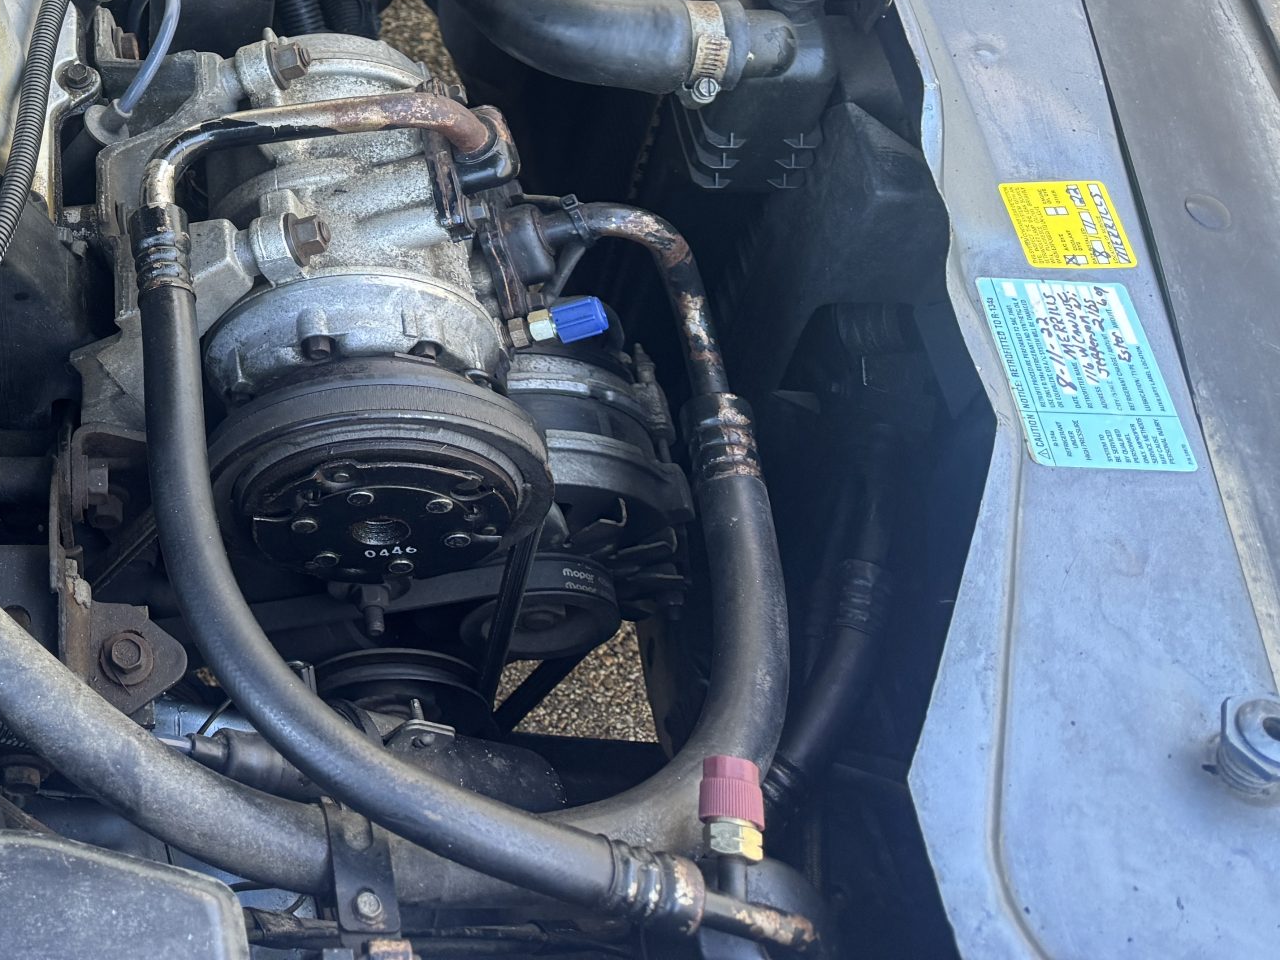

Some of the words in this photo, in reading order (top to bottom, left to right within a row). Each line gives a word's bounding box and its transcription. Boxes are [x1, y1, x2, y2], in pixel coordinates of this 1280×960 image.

[992, 319, 1003, 328] TO
[1101, 333, 1113, 352] AMOUNT
[996, 330, 1019, 377] RETROFITTED
[1110, 357, 1122, 376] CHARGE
[1071, 396, 1081, 408] DATE
[1094, 386, 1108, 409] ADDRESS
[1118, 377, 1135, 411] REFRIGERANT
[1026, 414, 1044, 447] CAUTION
[1055, 421, 1072, 457] REFRIGERANT
[1067, 430, 1079, 448] UNDER
[1071, 419, 1087, 447] PRESSURE
[1098, 433, 1105, 441] TO
[1135, 417, 1149, 442] METHODS
[1101, 441, 1113, 462] SYSTEM
[1104, 429, 1118, 454] SERVICED
[1113, 428, 1128, 455] QUALIFIED
[1124, 433, 1140, 463] PERSONNEL
[1151, 435, 1163, 453] CAUSE
[1160, 438, 1175, 464] PERSONAL
[1082, 447, 1092, 460] HIGH
[1124, 455, 1131, 463] BY
[1145, 443, 1158, 464] SERVICE
[1158, 453, 1167, 464] MAY
[364, 546, 417, 558] 0446
